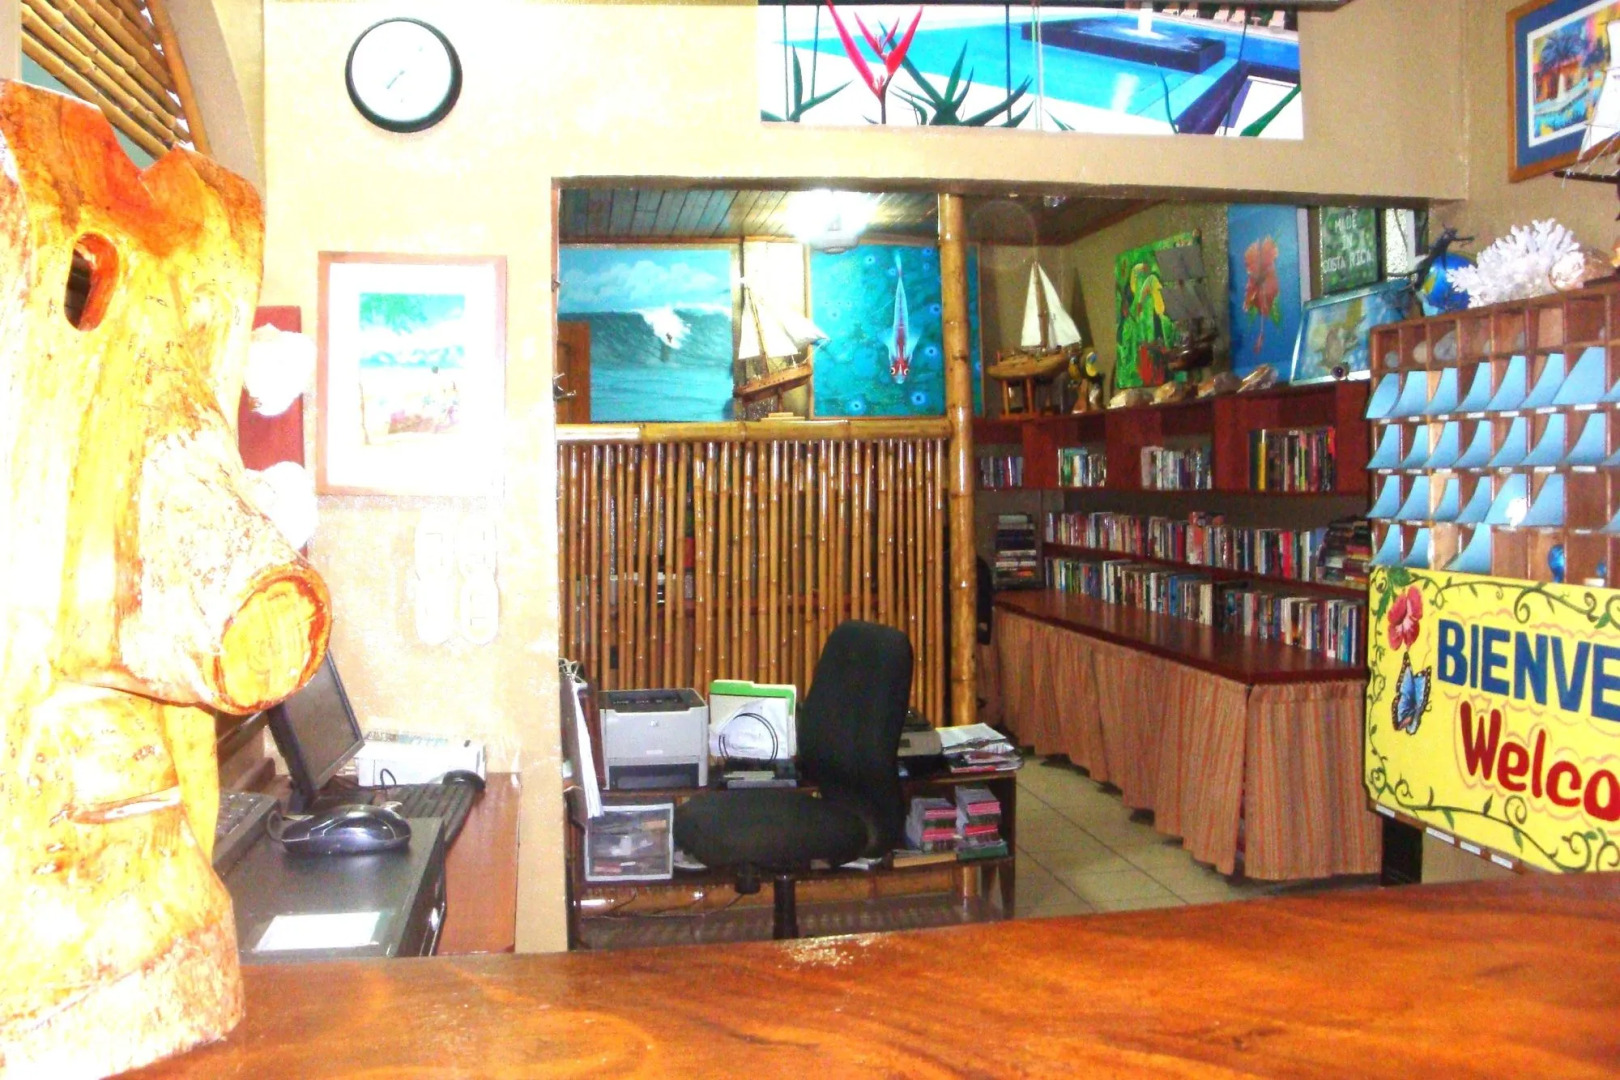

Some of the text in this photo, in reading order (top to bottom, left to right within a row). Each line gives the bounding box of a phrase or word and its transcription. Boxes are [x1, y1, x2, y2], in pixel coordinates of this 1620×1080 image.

[1323, 249, 1372, 274] COSTA RICA
[1437, 618, 1620, 722] BIENVE
[1460, 701, 1620, 822] Welco
